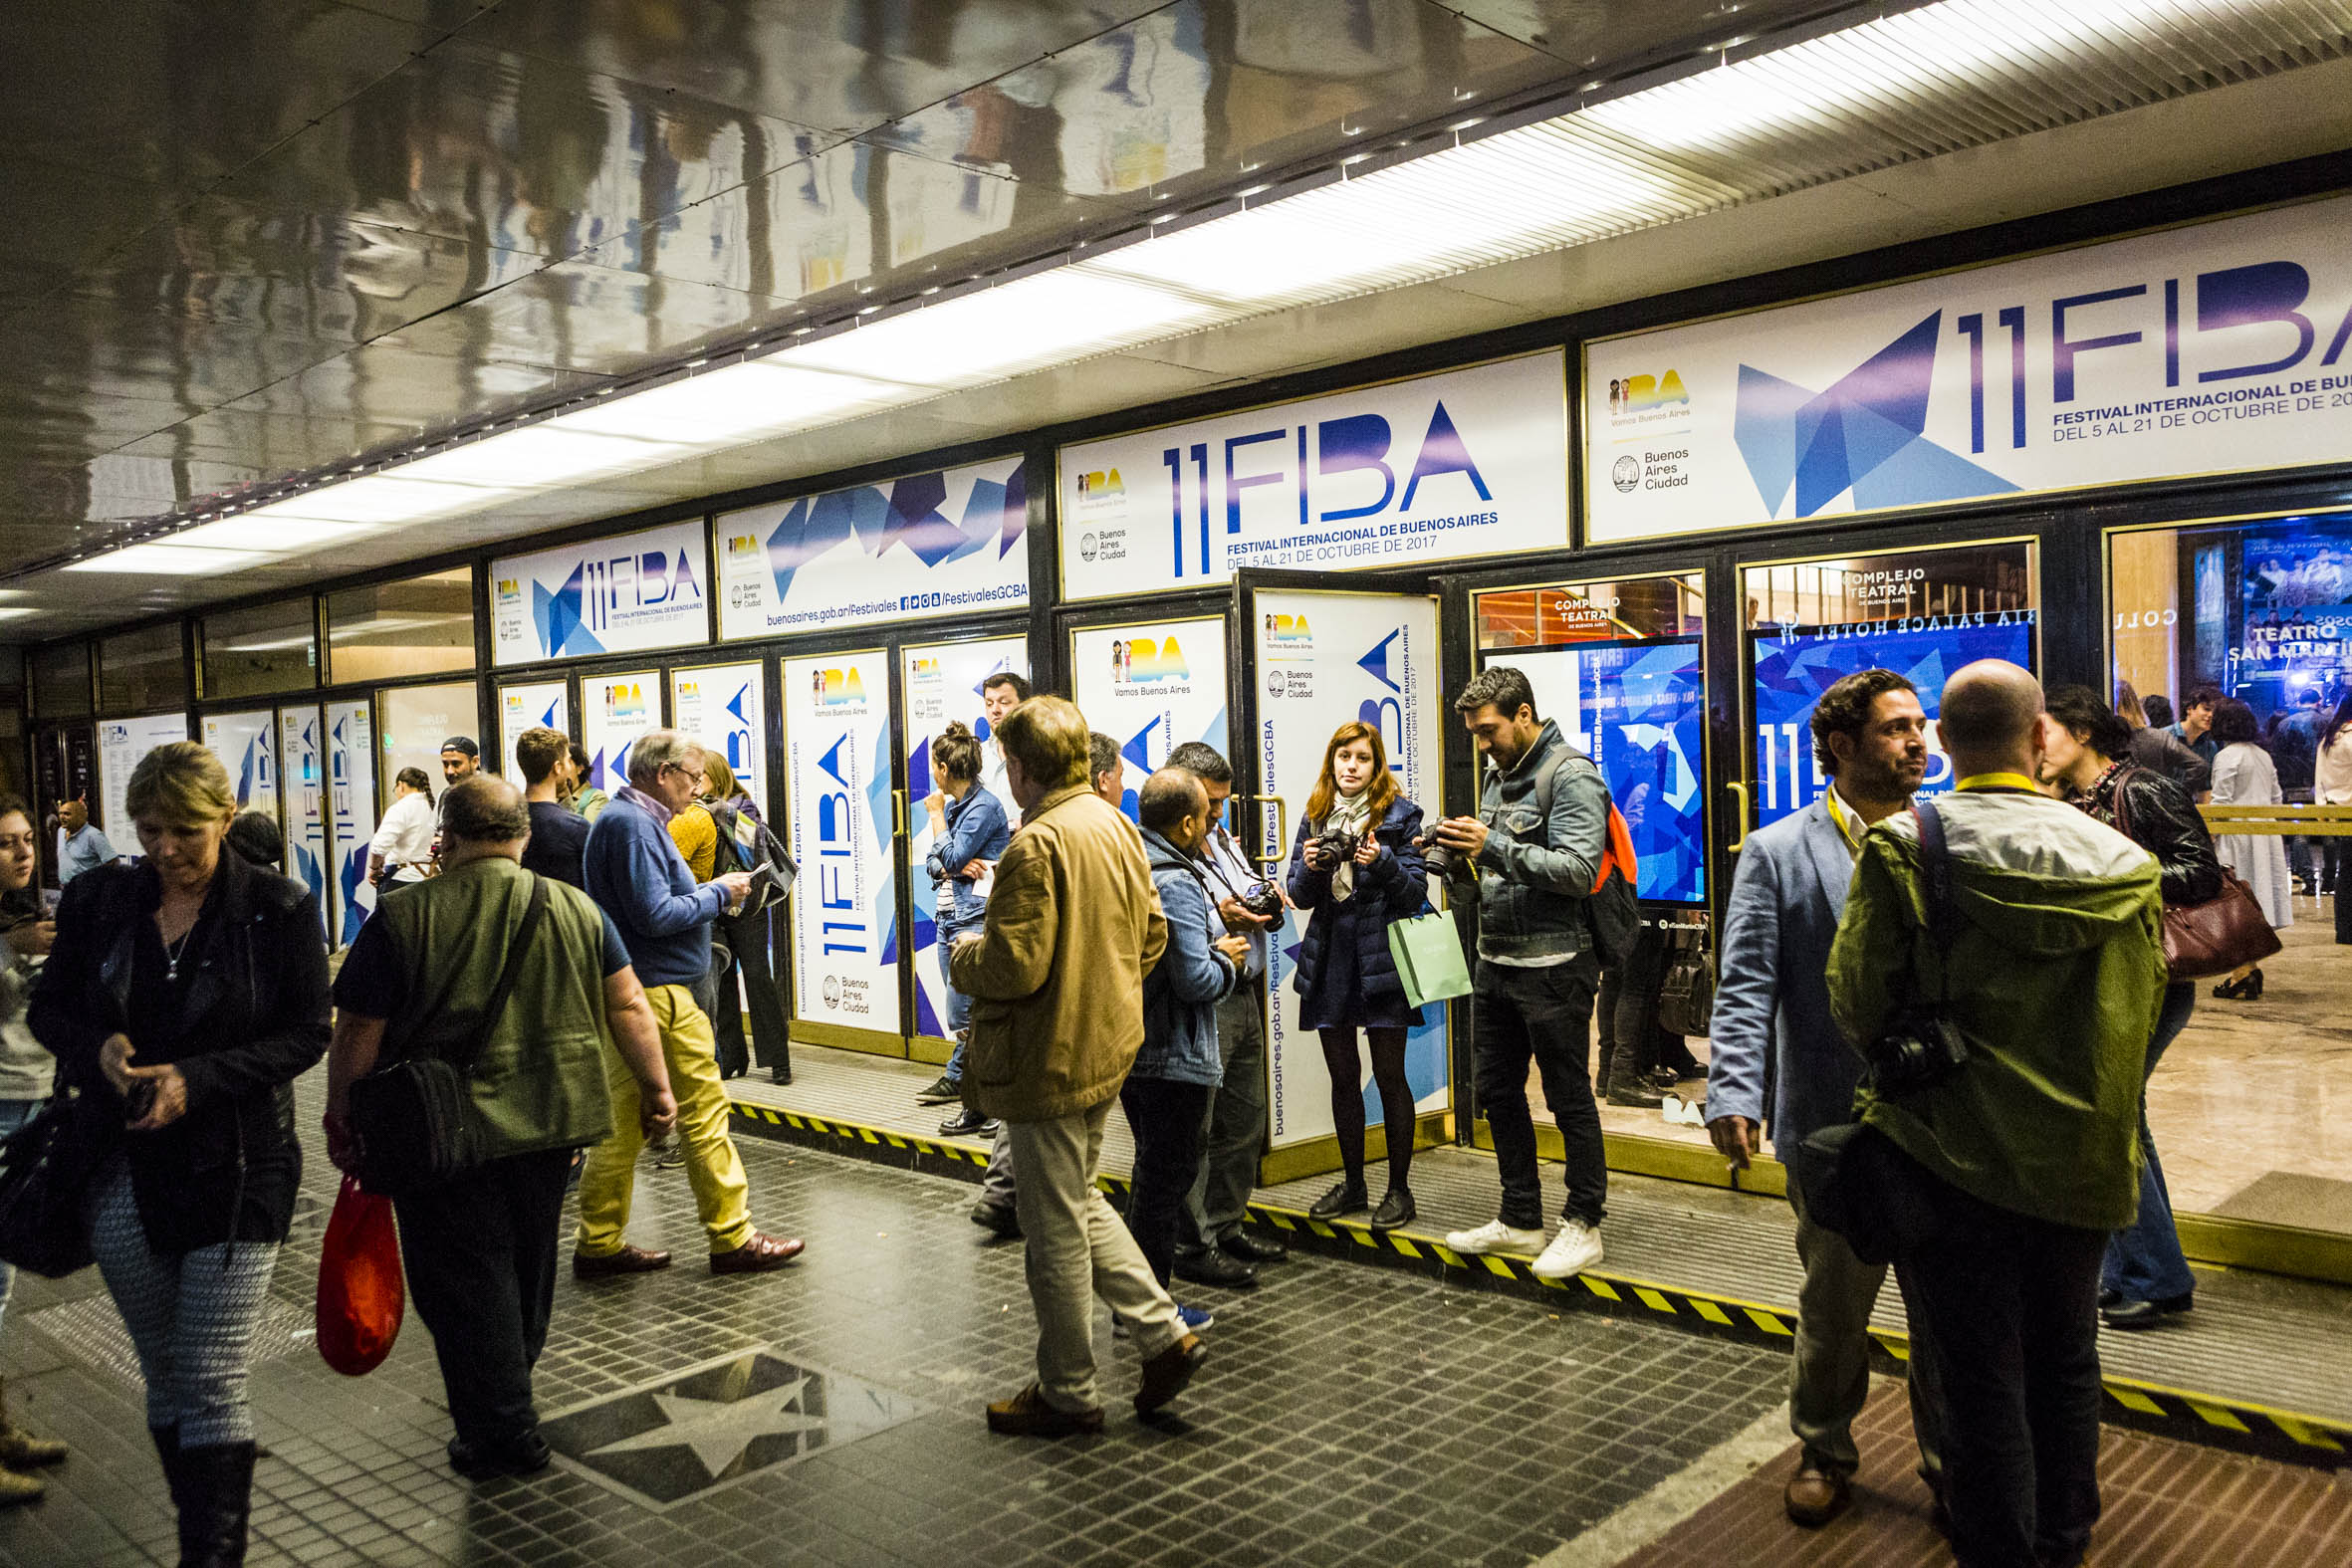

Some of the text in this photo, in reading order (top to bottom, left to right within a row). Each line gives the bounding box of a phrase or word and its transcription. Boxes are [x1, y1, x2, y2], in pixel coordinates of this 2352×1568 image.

[2053, 407, 2131, 426] FESTIVAL
[2134, 385, 2285, 414] INTERNACIONAL
[2290, 379, 2317, 394] DE
[1611, 408, 1690, 427] Vamos Buenos Aires
[2053, 427, 2087, 442] DEL
[2092, 424, 2102, 437] 5
[2106, 420, 2129, 436] AL
[2134, 417, 2153, 432] 21
[2160, 414, 2186, 429] DE
[2191, 400, 2289, 424] OCTUBRE
[2296, 395, 2324, 411] DE
[1644, 449, 1689, 463] Buenos
[1644, 464, 1678, 477] Aires
[1644, 473, 1688, 490] Ciudad
[1099, 530, 1126, 540] Buenos
[1227, 511, 1499, 556] FESTIVAL INTERNACIONAL DE BUENOS AIRES
[1099, 541, 1120, 551] Aires
[1227, 535, 1437, 570] DEL 5 AL 21 DE OCTUBRE DE 2017
[1099, 549, 1126, 560] Ciudad
[743, 582, 761, 591] Buenos
[1849, 582, 1917, 598] TEATRAL
[942, 583, 1028, 606] /festivalesGCBA
[767, 599, 897, 626] buenosaires.gob.ar/festivales
[1560, 610, 1613, 622] TEATRAL
[2252, 624, 2338, 642] TEATRO
[2229, 638, 2352, 662] SAN MARTÍ
[1114, 685, 1191, 697] Vamos Buenos Aires
[1287, 680, 1306, 689] Aires
[1288, 689, 1313, 698] Ciudad
[1410, 692, 1417, 706] DE
[1405, 696, 1411, 708] DE
[832, 708, 851, 717] Buenos
[1413, 762, 1419, 775] DE
[1413, 777, 1419, 787] 21
[841, 977, 869, 989] Buenos
[842, 990, 861, 1001] Aires
[842, 1003, 869, 1013] Ciudad
